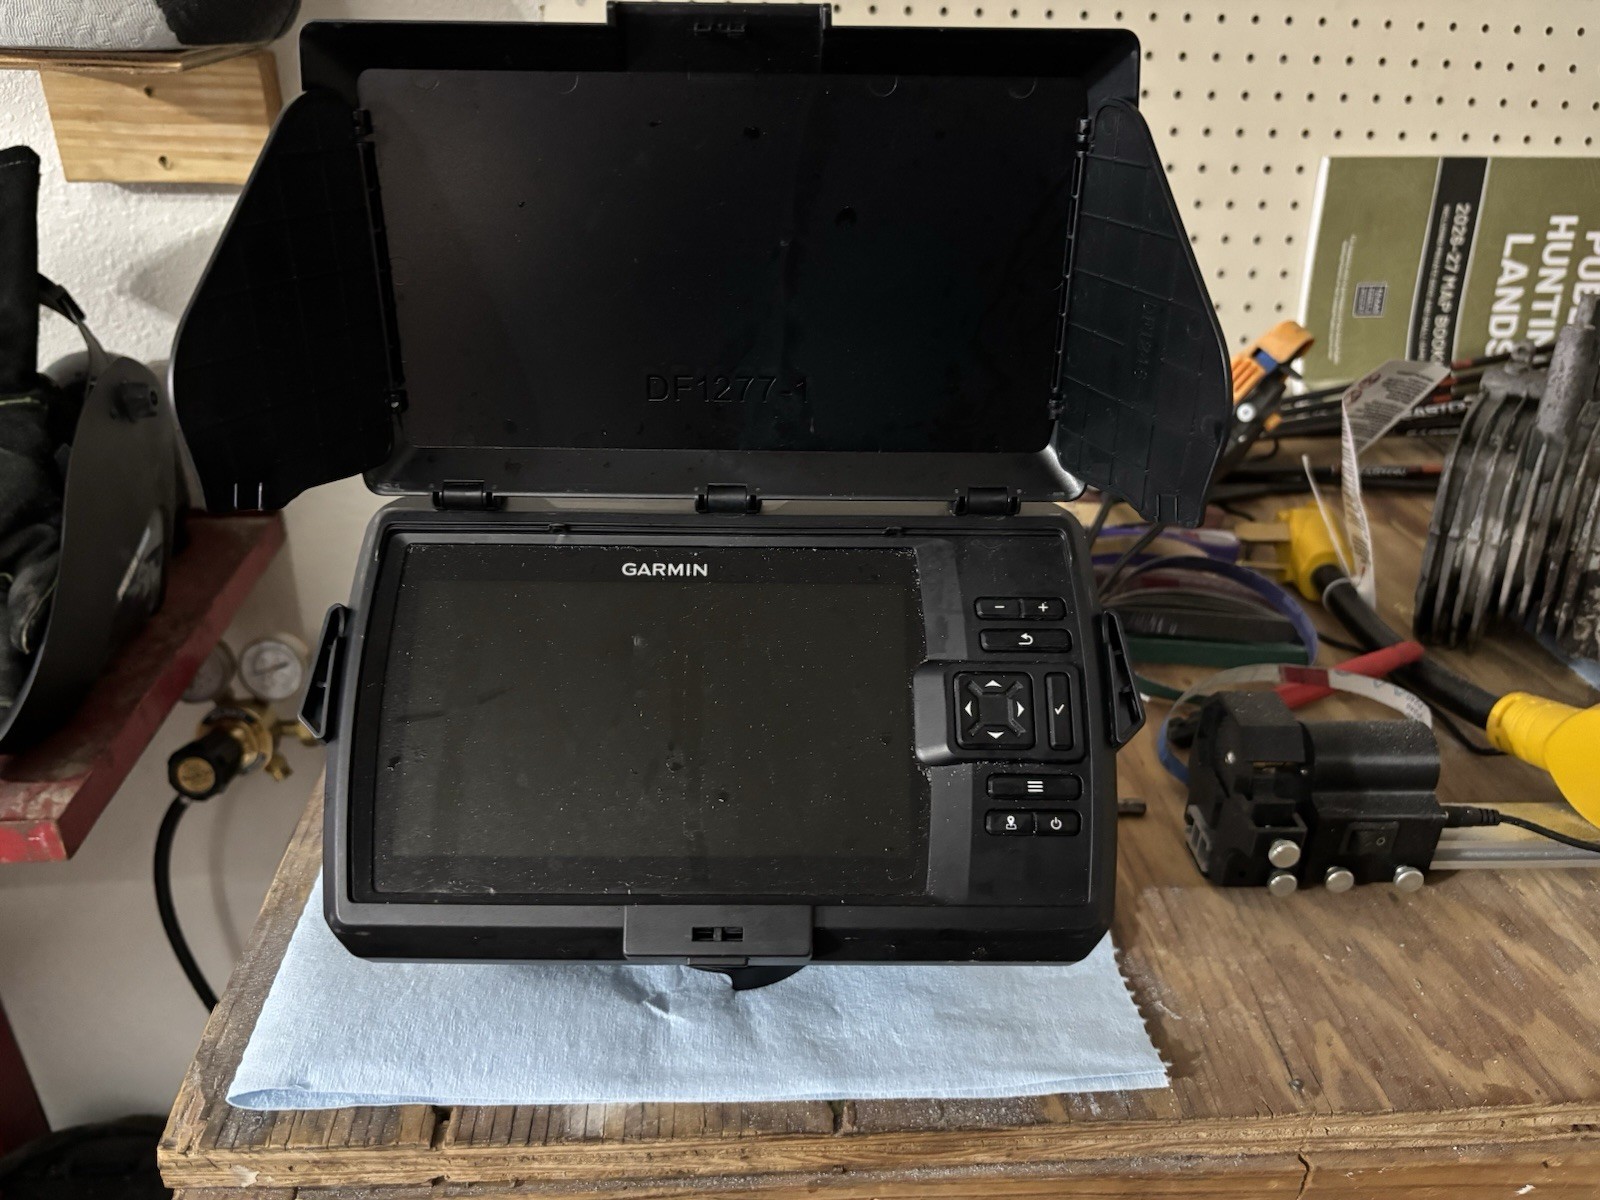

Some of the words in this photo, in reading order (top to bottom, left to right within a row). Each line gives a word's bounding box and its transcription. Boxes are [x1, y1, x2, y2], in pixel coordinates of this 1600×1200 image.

[1437, 274, 1457, 313] MAP
[1485, 233, 1516, 357] LANDS
[1527, 215, 1579, 363] HUNTIN
[646, 374, 808, 404] DF1277-1
[621, 562, 708, 577] GARMIN
